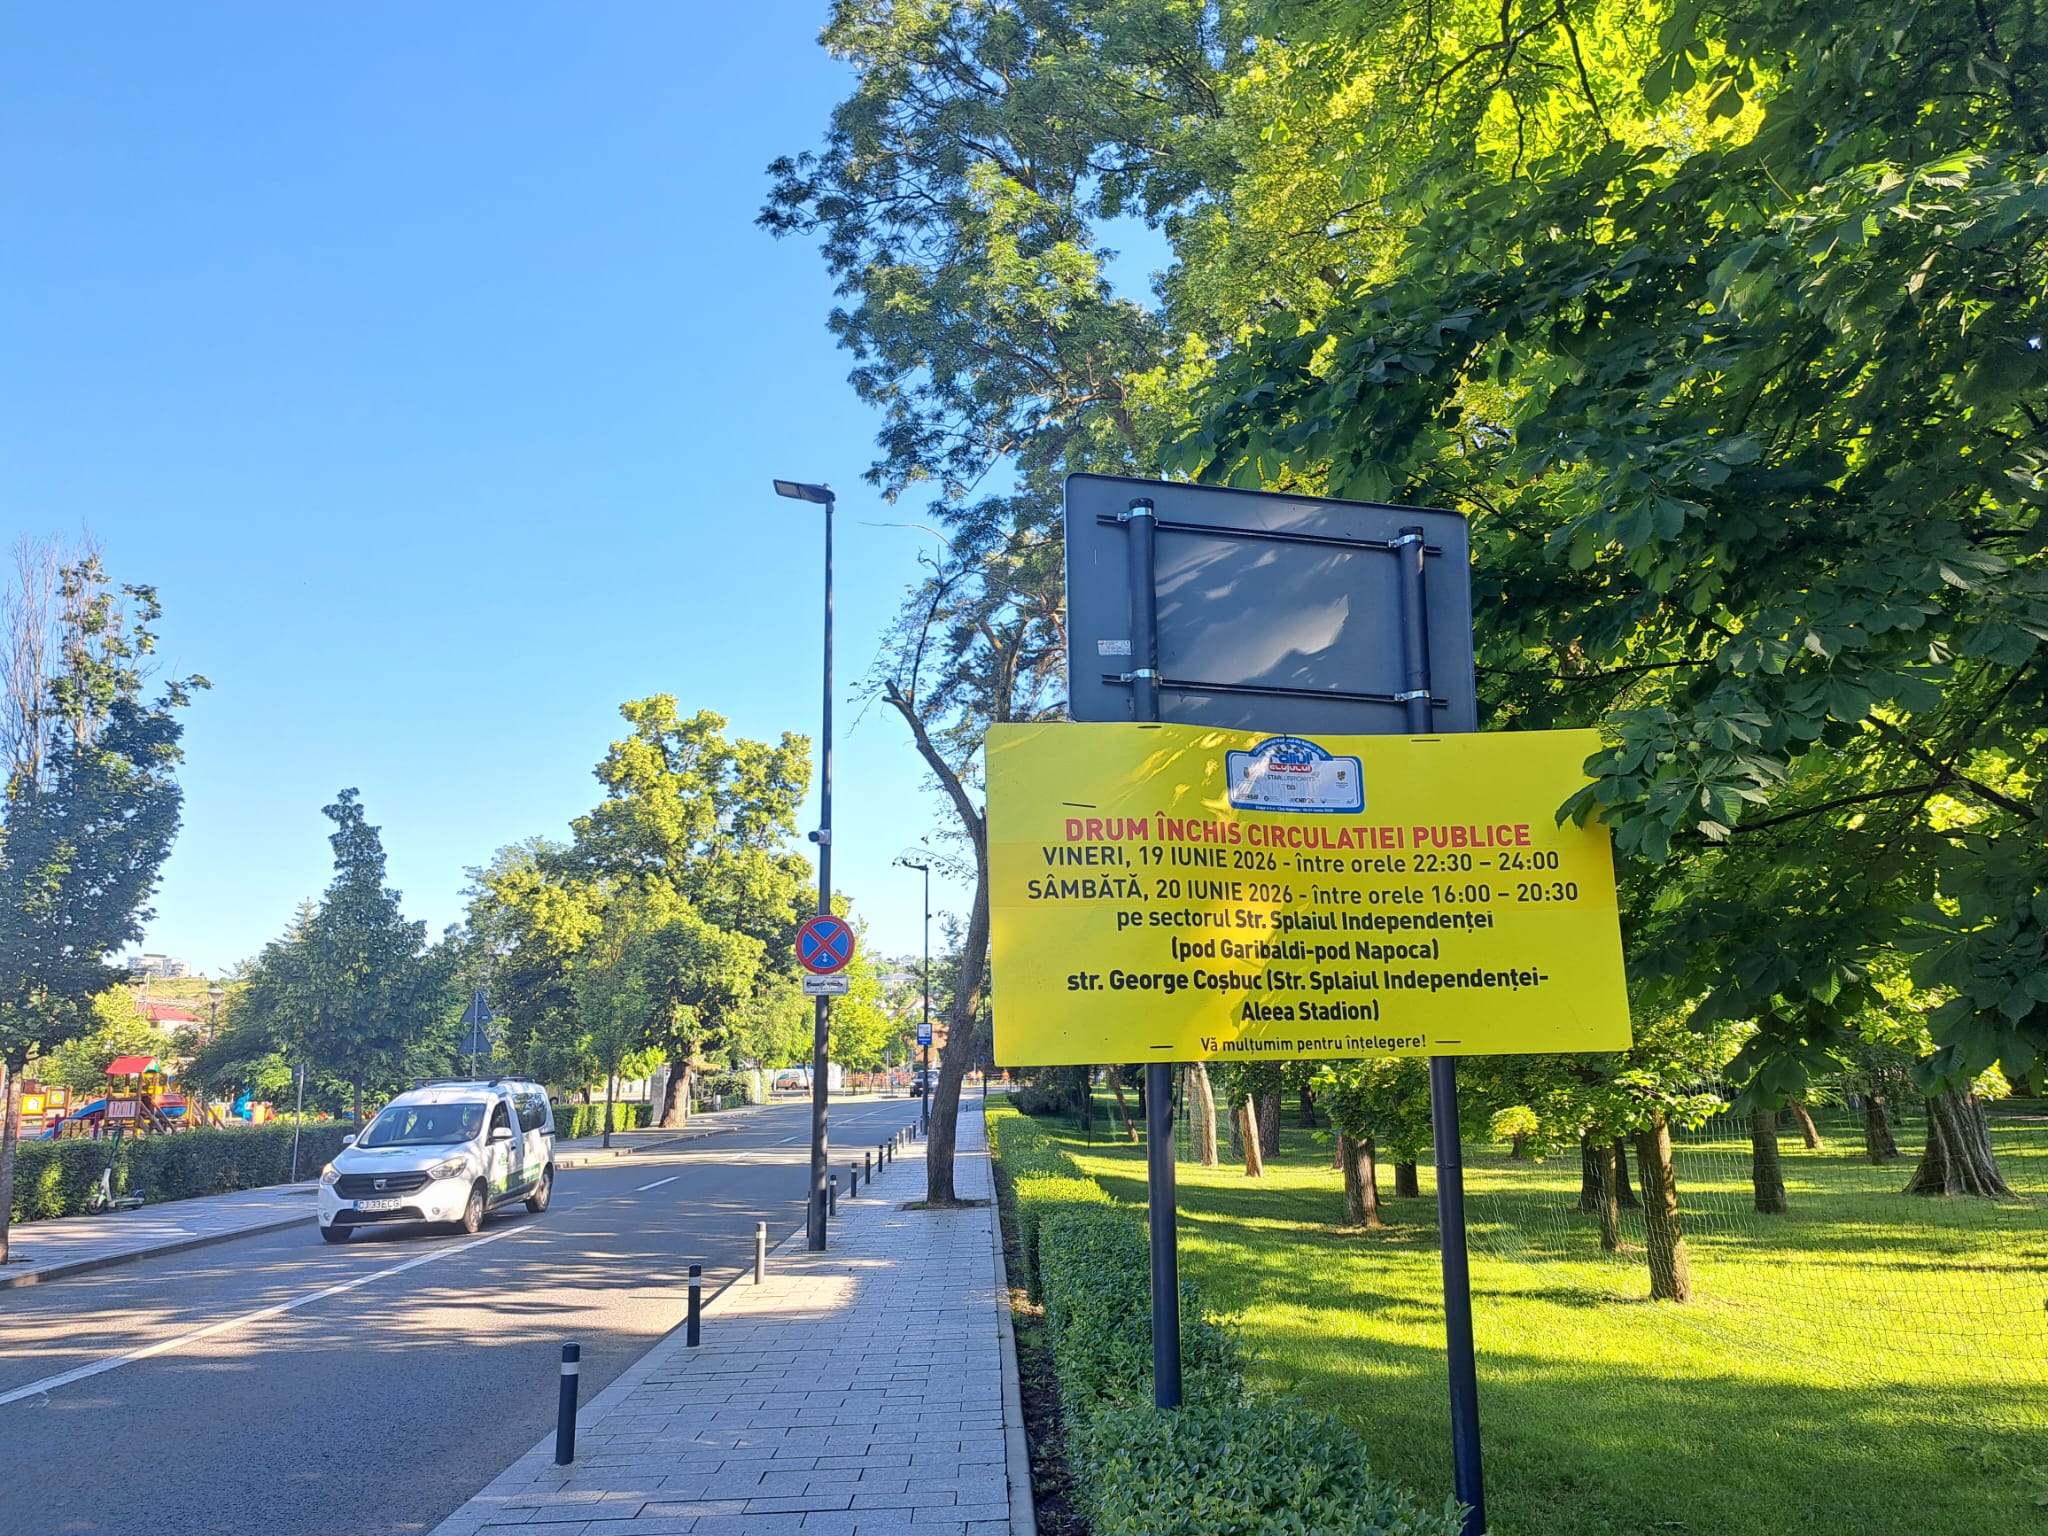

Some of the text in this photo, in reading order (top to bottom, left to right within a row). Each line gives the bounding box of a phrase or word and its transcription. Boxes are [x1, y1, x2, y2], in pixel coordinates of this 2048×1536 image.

[1066, 811, 1531, 849] DRUM ÎNCHIS CIRCULATIEI PUBLICE
[1043, 846, 1130, 868] VINERI,
[1140, 846, 1163, 865] 19
[1171, 847, 1227, 868] IUNIE
[1233, 850, 1276, 871] 2026
[1295, 852, 1344, 872] între
[1351, 855, 1406, 872] orele
[1413, 854, 1472, 872] 22:30
[1499, 851, 1558, 870] 24:00
[1028, 874, 1148, 901] SÂMBĂTĂ,
[1156, 879, 1180, 898] 20
[1188, 880, 1242, 901] IUNIE
[1249, 883, 1293, 903] 2026
[1312, 884, 1361, 904] între
[1369, 886, 1423, 904] orele
[1432, 884, 1490, 903] 16:00
[1517, 882, 1577, 901] 20:30
[1118, 909, 1493, 934] pe sectorul Str. Splaiul Independenței
[1172, 936, 1438, 964] (pod Garibaldi-pod Napoca)
[1068, 967, 1548, 994] str. George Coșbuc (Str. Splaiul Independenței-
[1241, 999, 1379, 1021] Aleea Stadion)
[1201, 1034, 1426, 1054] Vă mulțumim pentru înțelegere!
